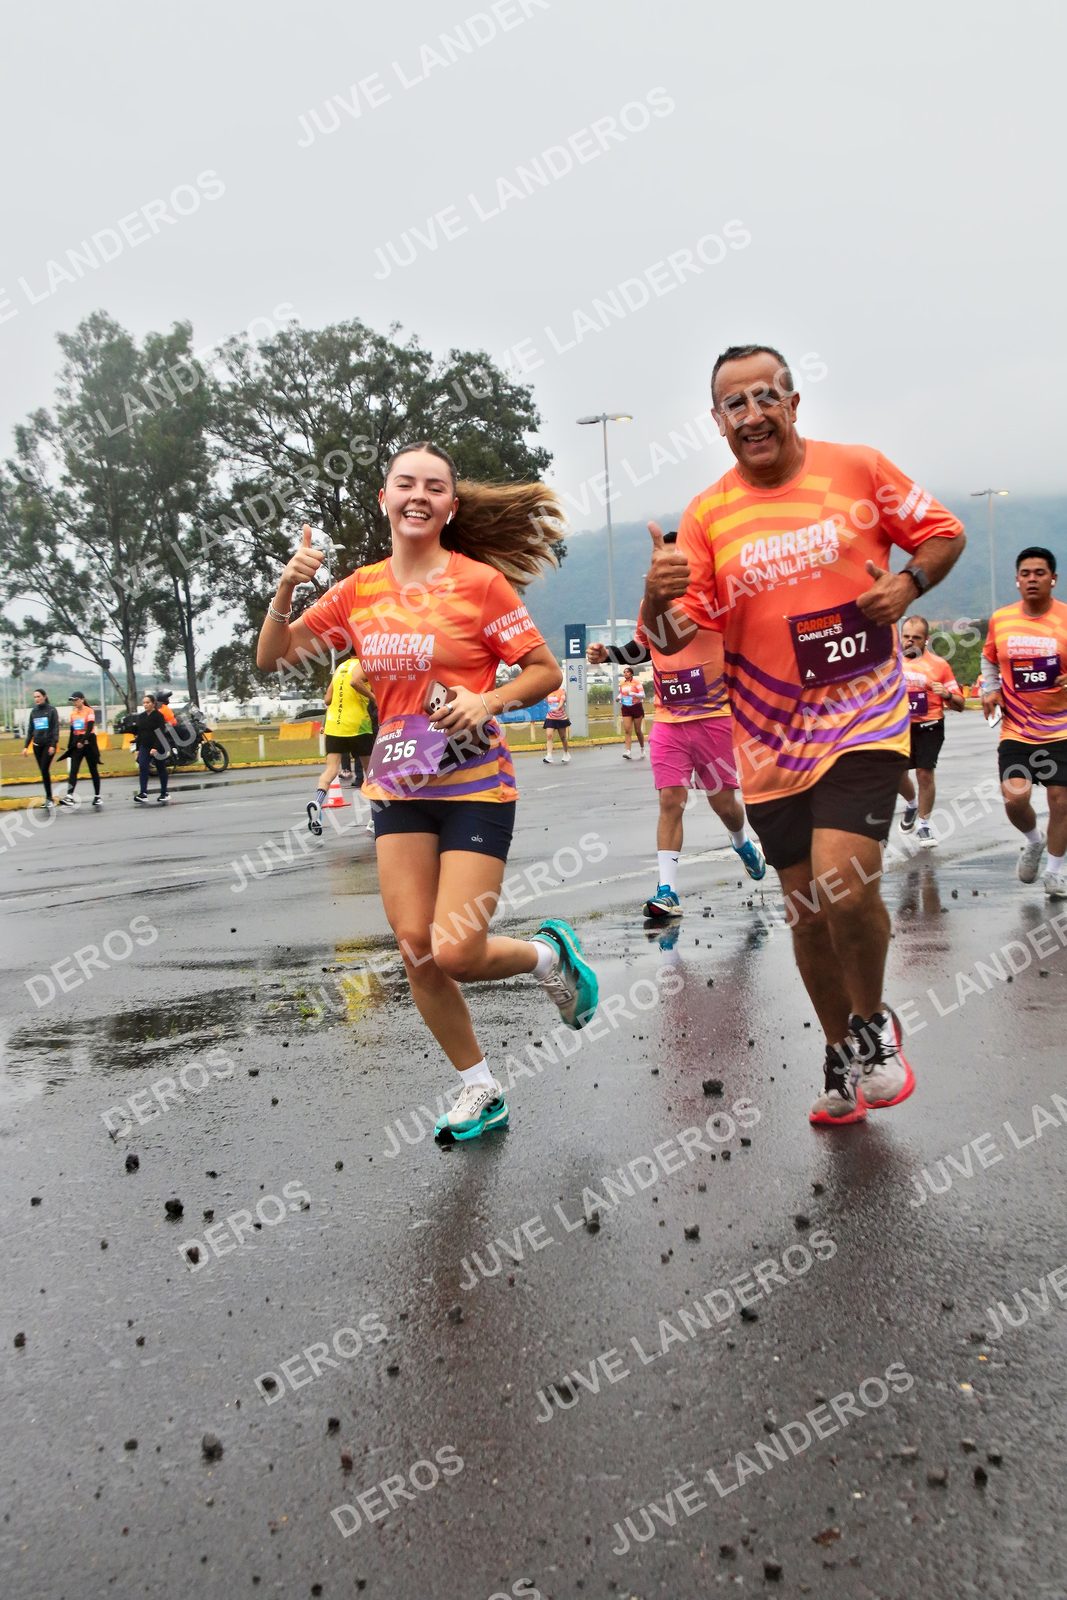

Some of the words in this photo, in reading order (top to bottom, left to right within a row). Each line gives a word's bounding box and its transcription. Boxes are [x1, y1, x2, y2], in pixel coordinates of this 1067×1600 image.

[741, 519, 838, 567] CARRERA
[743, 553, 819, 584] OMNILIFE
[797, 613, 842, 633] CARRERA
[361, 632, 435, 656] CARRERA
[798, 628, 834, 642] OMNILIFE
[569, 638, 581, 655] E
[824, 631, 867, 663] 207
[361, 657, 414, 673] OMNILIFE
[1022, 671, 1047, 683] 768
[669, 683, 691, 695] 613
[382, 740, 417, 763] 256
